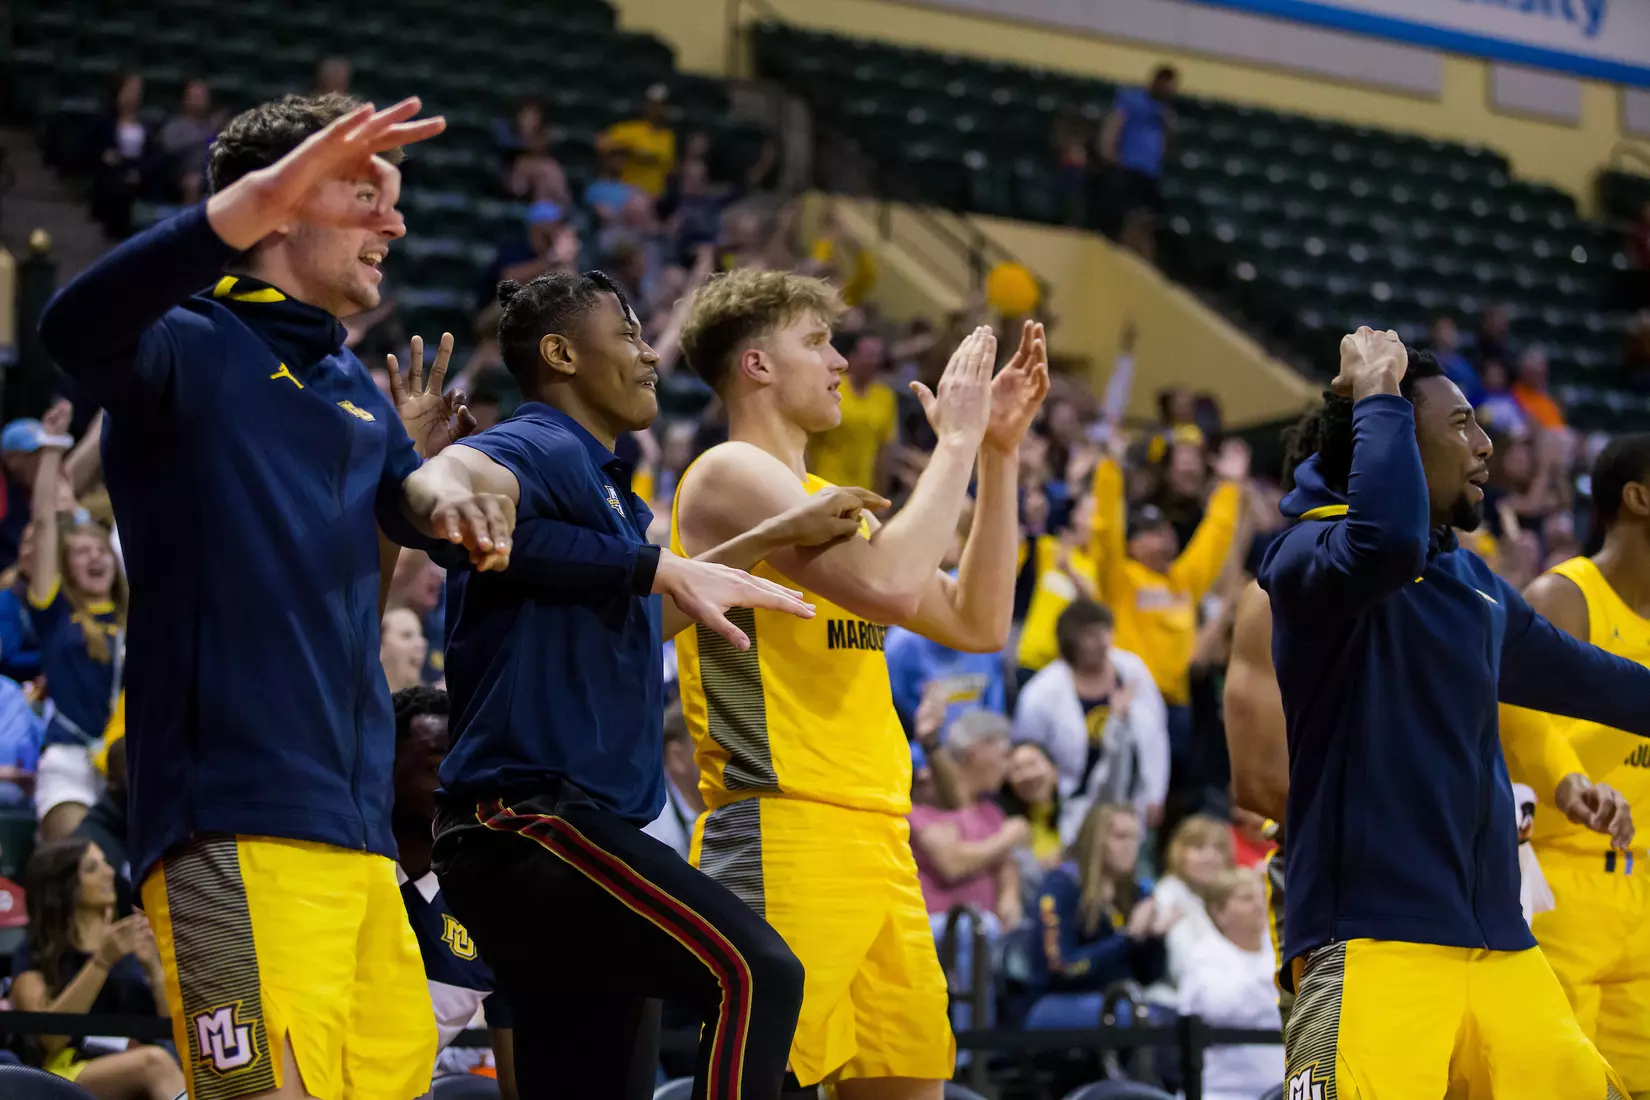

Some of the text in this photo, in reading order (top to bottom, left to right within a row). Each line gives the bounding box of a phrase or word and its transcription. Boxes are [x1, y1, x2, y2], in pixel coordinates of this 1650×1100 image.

[827, 619, 887, 651] MARQU
[445, 917, 475, 957] MU
[195, 1005, 256, 1071] MU
